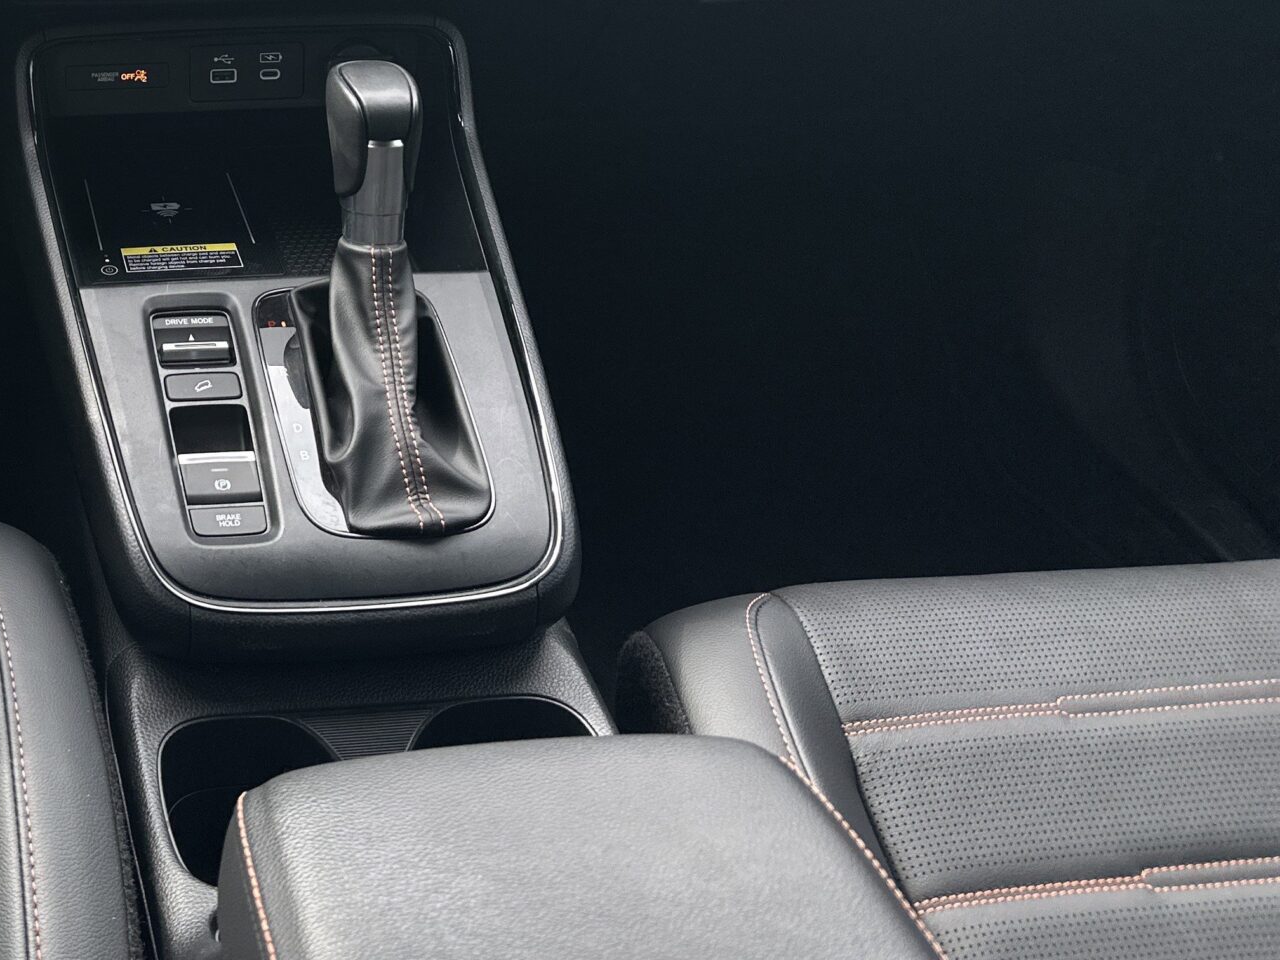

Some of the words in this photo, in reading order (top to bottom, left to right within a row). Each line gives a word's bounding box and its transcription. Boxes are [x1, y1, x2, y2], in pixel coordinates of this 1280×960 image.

[120, 73, 135, 81] OFF
[293, 423, 302, 433] D
[300, 450, 310, 460] B
